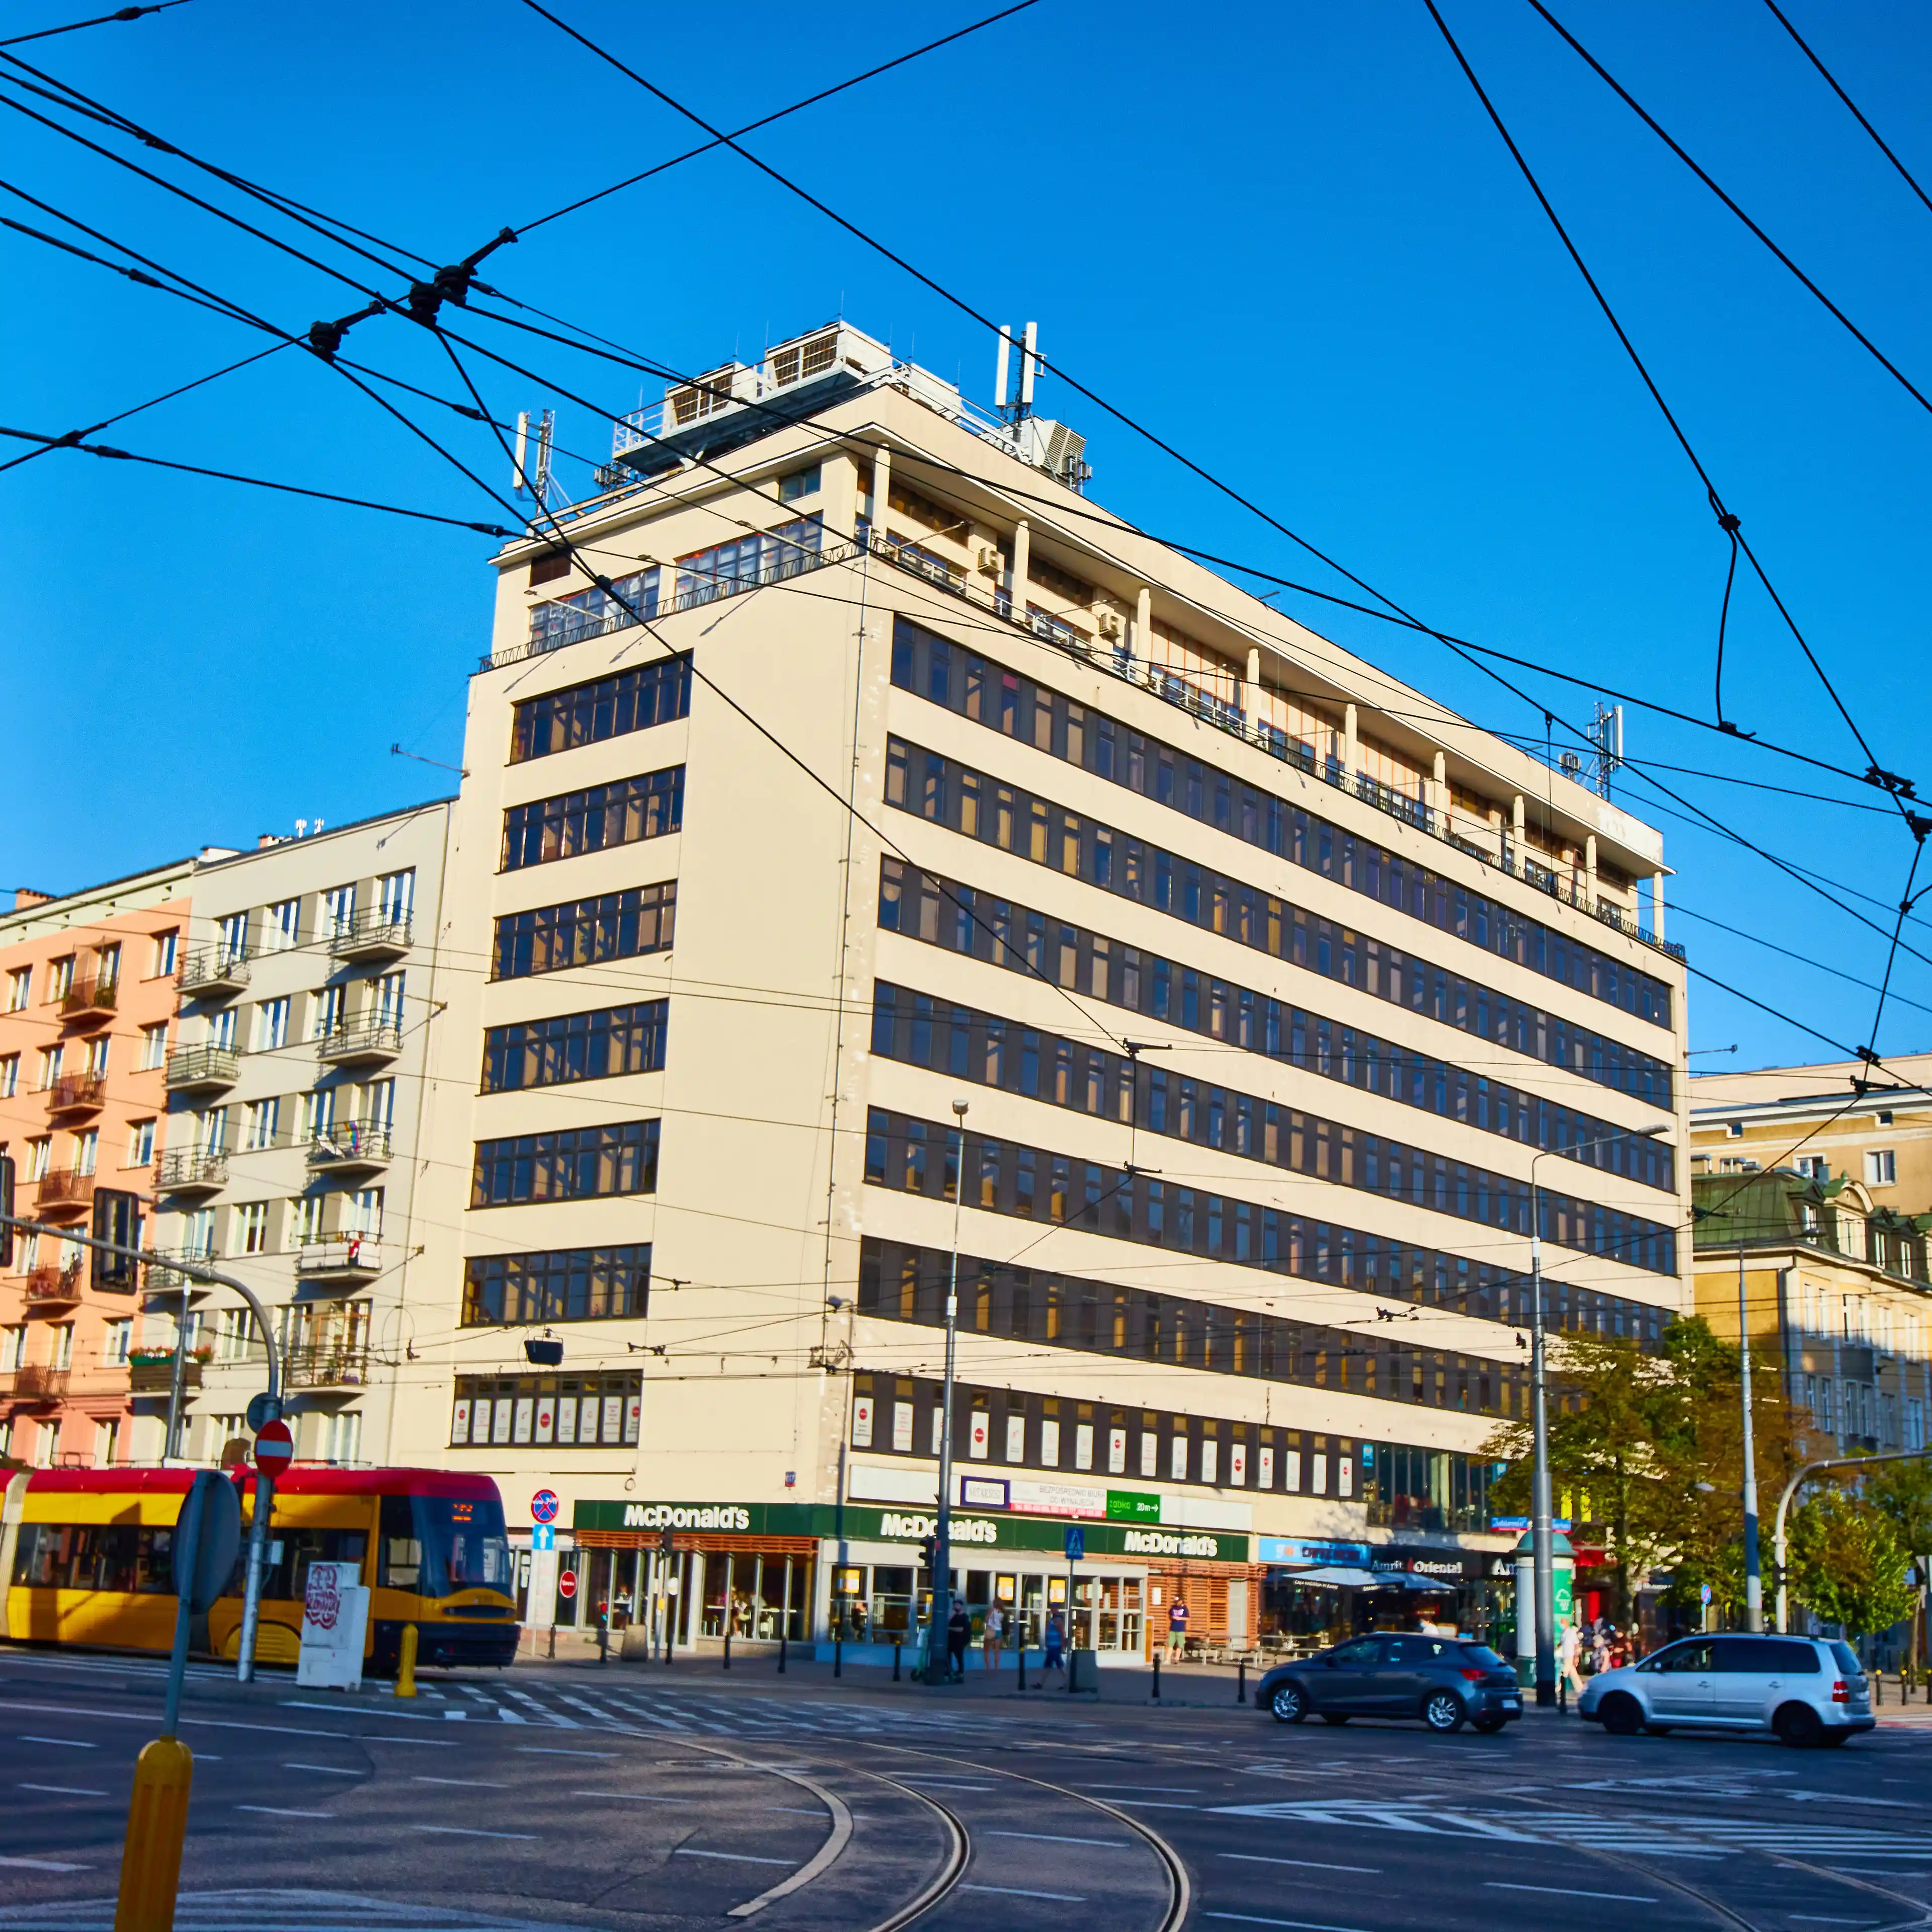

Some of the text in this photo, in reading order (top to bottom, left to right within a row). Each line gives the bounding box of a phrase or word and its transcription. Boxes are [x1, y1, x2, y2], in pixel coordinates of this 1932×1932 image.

[1137, 1502, 1151, 1511] 20m
[624, 1505, 749, 1530] McDonald's
[1123, 1531, 1218, 1557] McDonald's
[1413, 1560, 1463, 1574] Oriental
